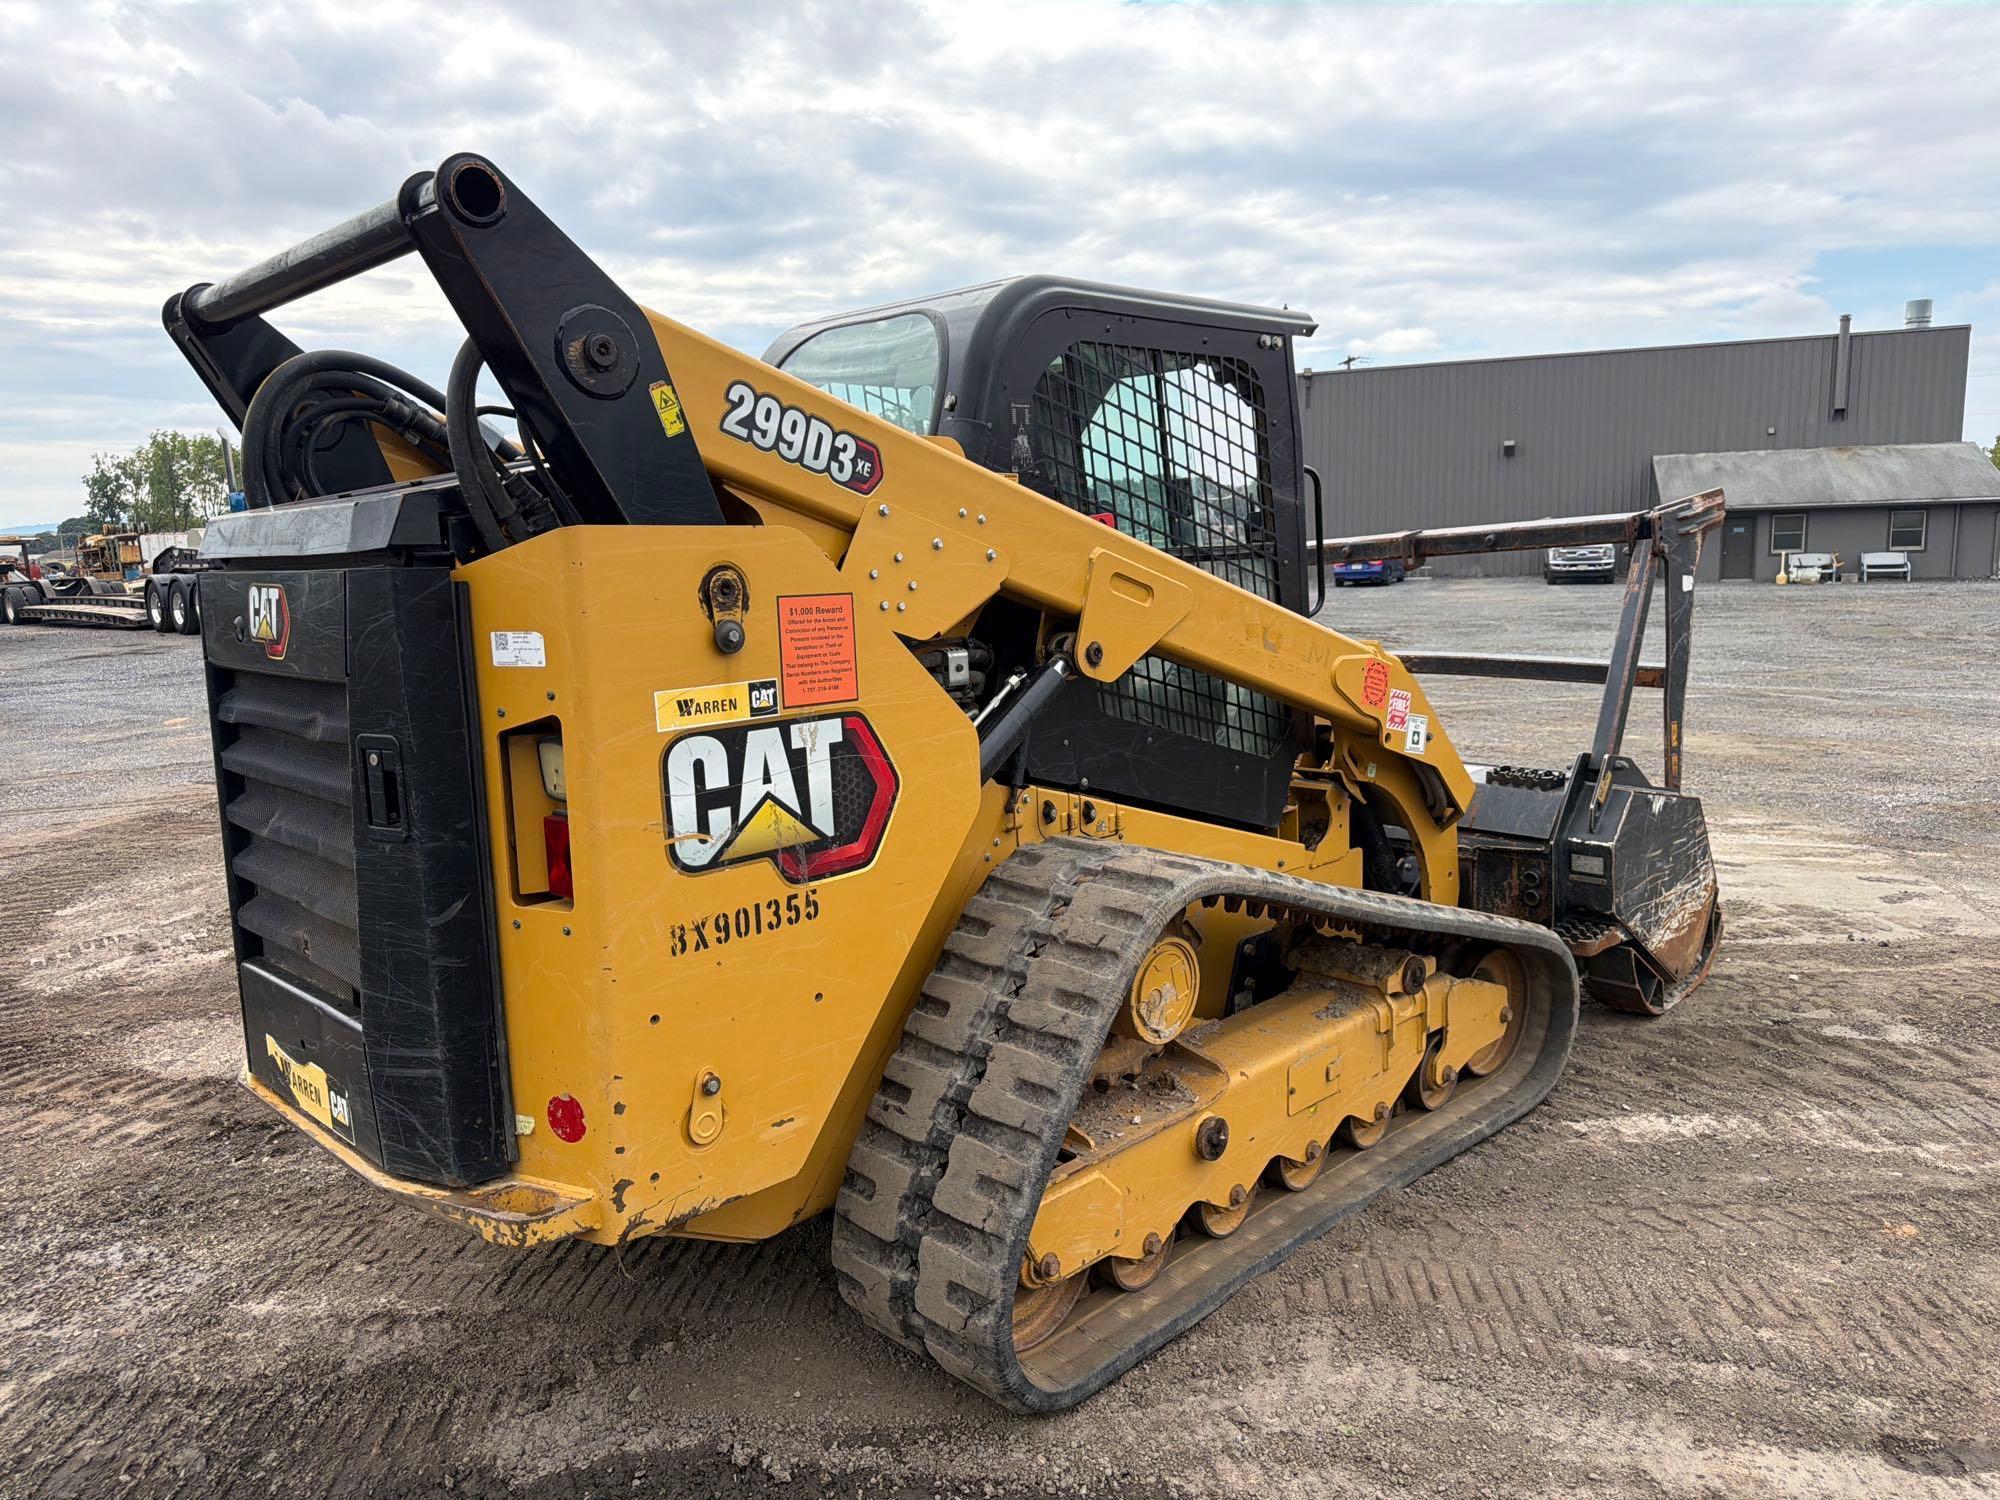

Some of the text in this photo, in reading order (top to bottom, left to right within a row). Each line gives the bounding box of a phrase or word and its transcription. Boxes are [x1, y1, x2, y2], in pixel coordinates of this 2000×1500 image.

[722, 384, 872, 482] 299D3 XE
[249, 586, 280, 640] CAT
[789, 606, 843, 617] $1,000 Reward
[676, 687, 774, 717] WARREN CAT
[667, 718, 844, 866] CAT
[330, 1090, 349, 1127] CAT
